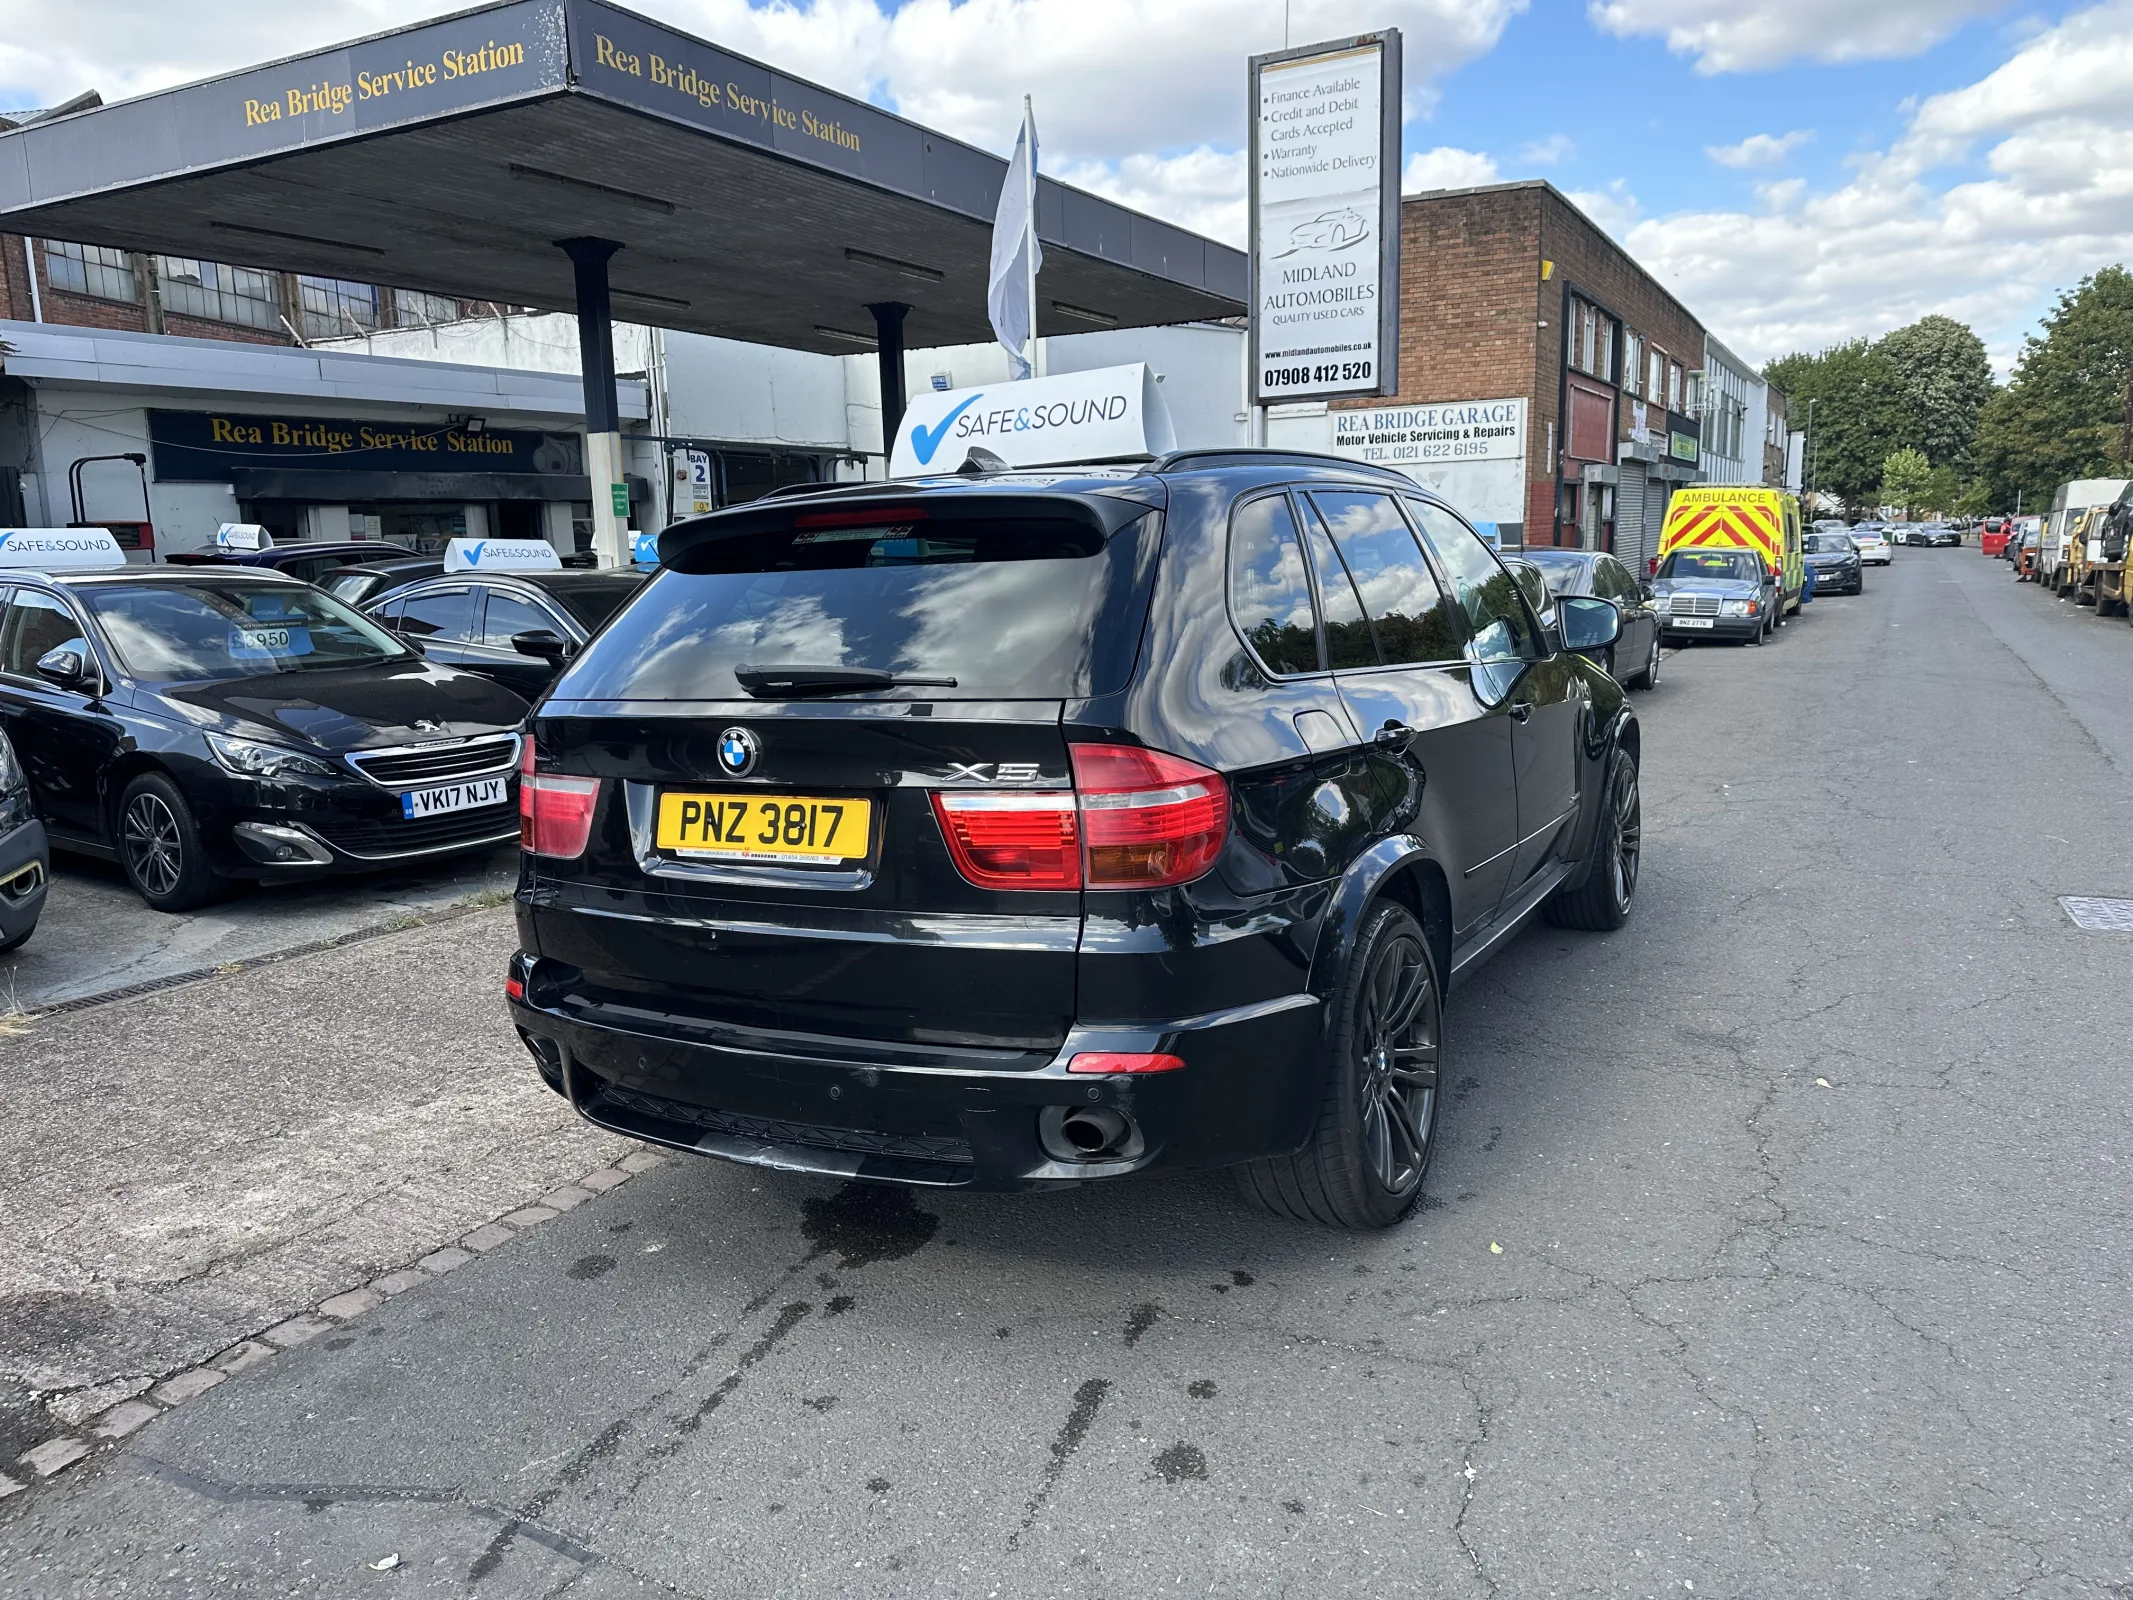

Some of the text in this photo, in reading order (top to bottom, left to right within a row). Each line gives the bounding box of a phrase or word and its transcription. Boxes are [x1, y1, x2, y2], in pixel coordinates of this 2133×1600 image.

[244, 40, 524, 126] Rea Bridge Service Station
[594, 33, 860, 152] Rea Bridge Service Station
[1271, 78, 1360, 104] Finance Available
[1271, 98, 1358, 122] Credit and Debit
[1271, 117, 1353, 142] Cards Accepted
[1271, 144, 1317, 160] Warranty
[1271, 154, 1377, 179] Nationwide Delivery
[1282, 262, 1356, 284] MIDLAND
[1264, 284, 1374, 310] AUTOMOBILES
[1272, 306, 1364, 325] QUALITY USED CARS
[1265, 342, 1372, 358] www.midlandautomobiles.co.uk
[1264, 361, 1371, 386] 07908 412 520
[956, 396, 1126, 438] SAFE&SOUND
[1338, 404, 1516, 432] REA BRIDGE GARAGE
[210, 418, 514, 454] Rea Bridge Service Station
[1336, 425, 1516, 446] Motor Vehicle Servicing & Repairs
[690, 454, 708, 464] BAY
[1363, 442, 1488, 460] TEL. 0121 622 6195
[695, 464, 706, 482] 2
[1682, 492, 1766, 504] AMBULANCE
[7, 538, 110, 552] SAFE&SOUND
[483, 547, 552, 558] SAFE&SOUND
[940, 762, 1040, 782] X5
[420, 780, 498, 811] VK17 NJY
[680, 800, 844, 848] PNZ 3817
